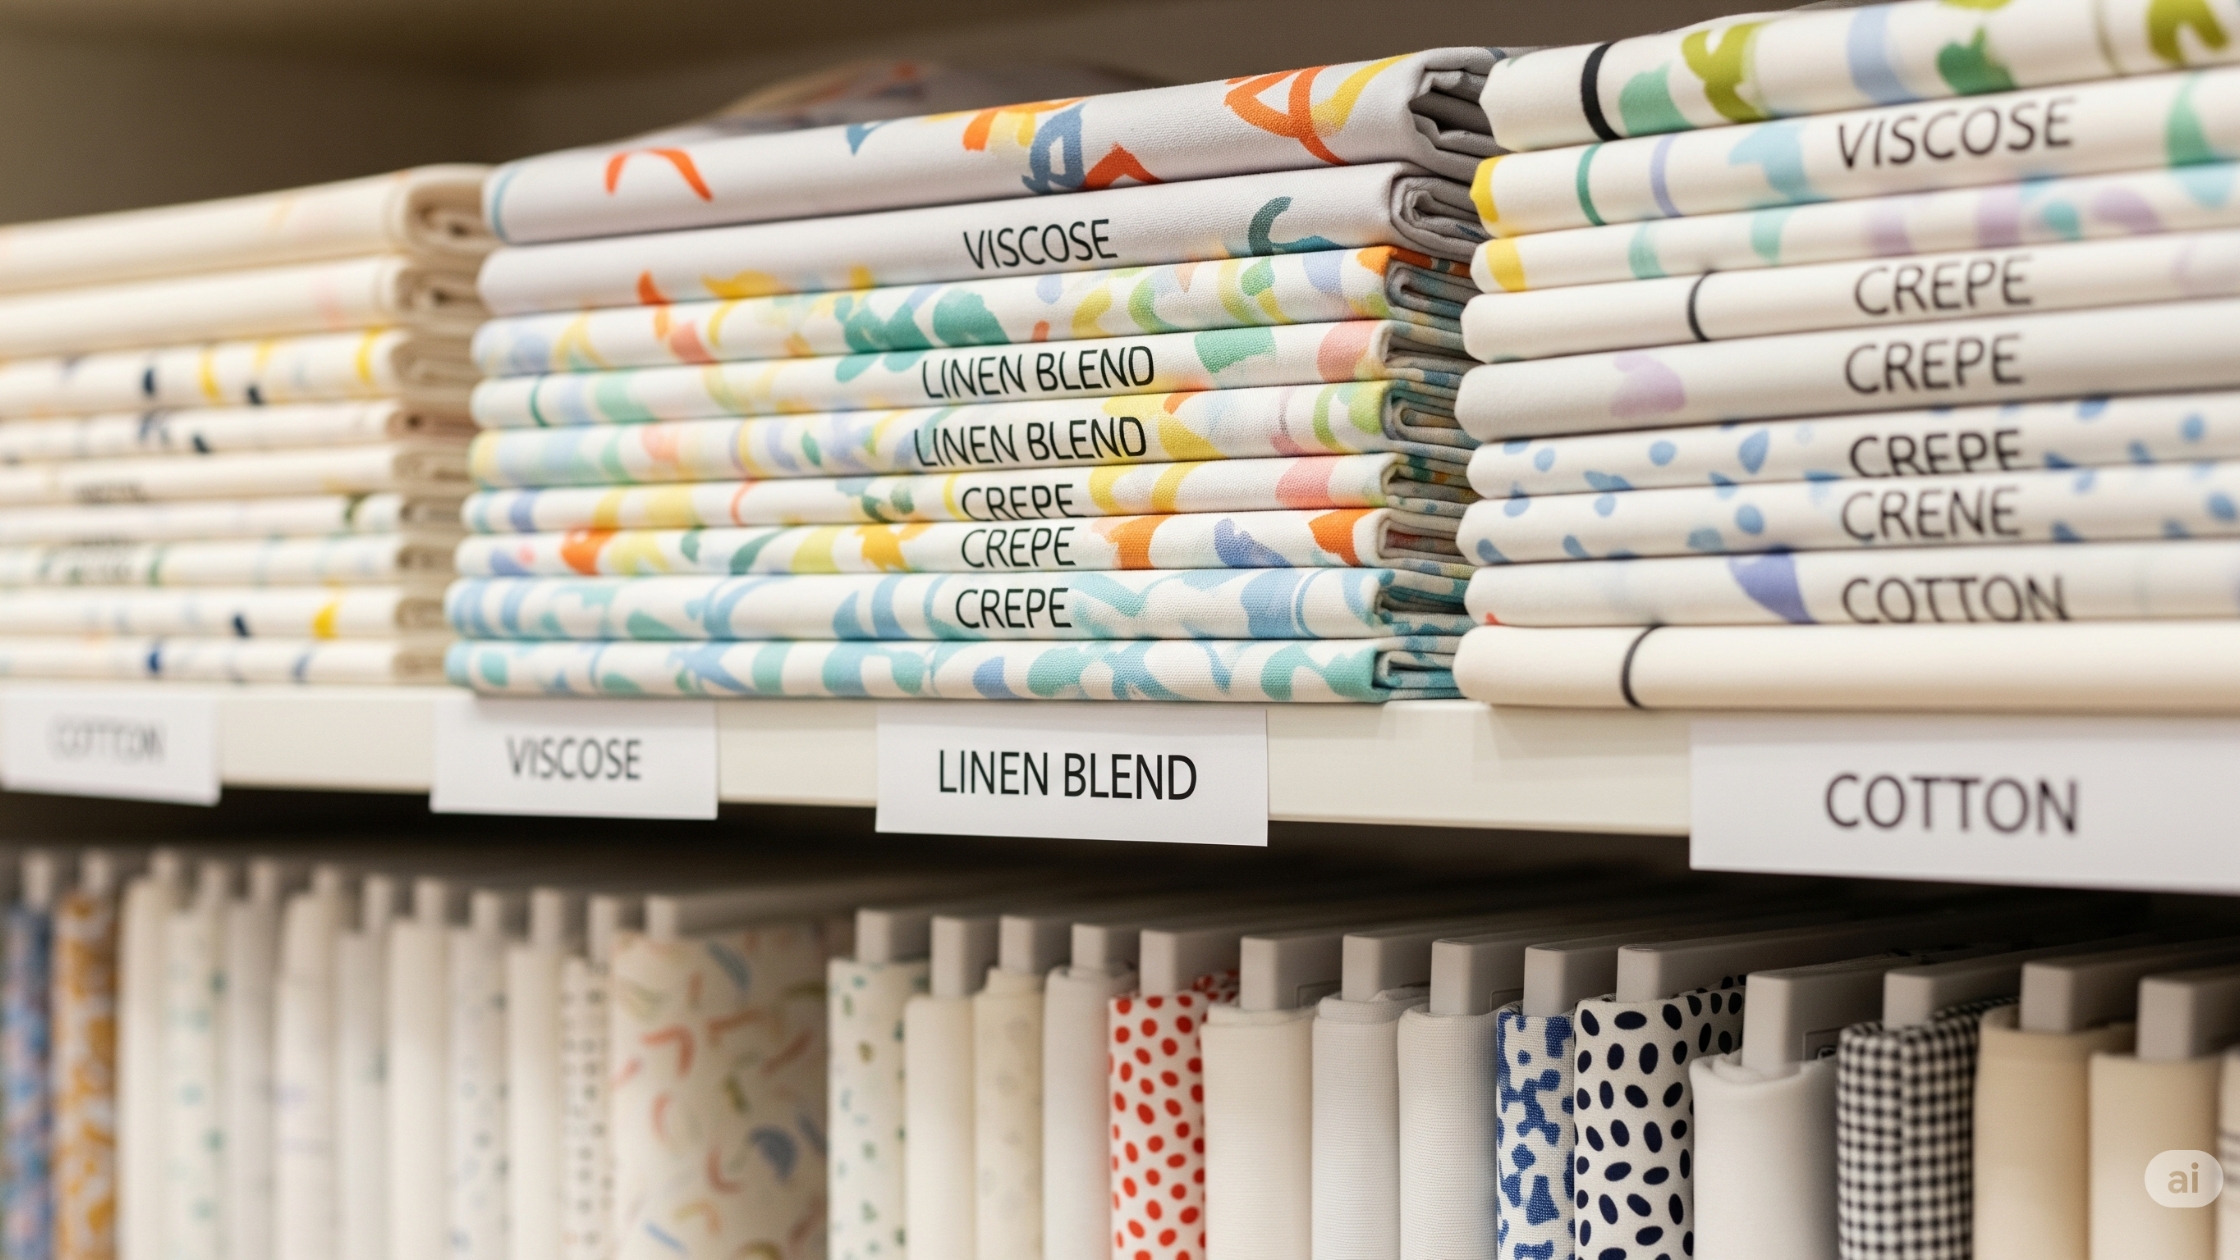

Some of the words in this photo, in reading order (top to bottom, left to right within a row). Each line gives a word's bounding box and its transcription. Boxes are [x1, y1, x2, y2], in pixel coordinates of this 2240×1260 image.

[1838, 96, 2078, 169] VISCOSE
[963, 218, 1118, 270] VISCOSE
[1854, 255, 2034, 317] CREPE
[922, 354, 1027, 399] LINEN
[1035, 346, 1155, 392] BLEND
[1845, 334, 2026, 395] CREPE
[914, 423, 1020, 467] LINEN
[1027, 416, 1147, 461] BLEND
[1850, 429, 2021, 478] CREPE
[961, 484, 1087, 522] CREPE
[1841, 486, 2022, 543] CRENE
[961, 526, 1076, 568] CREPE
[955, 587, 1073, 629] CREPE
[1841, 574, 2074, 625] COTTON
[506, 737, 643, 782] VISCOSE
[938, 750, 1050, 796] LINEN
[1063, 751, 1198, 802] BLEND
[1825, 772, 2080, 836] COTTON
